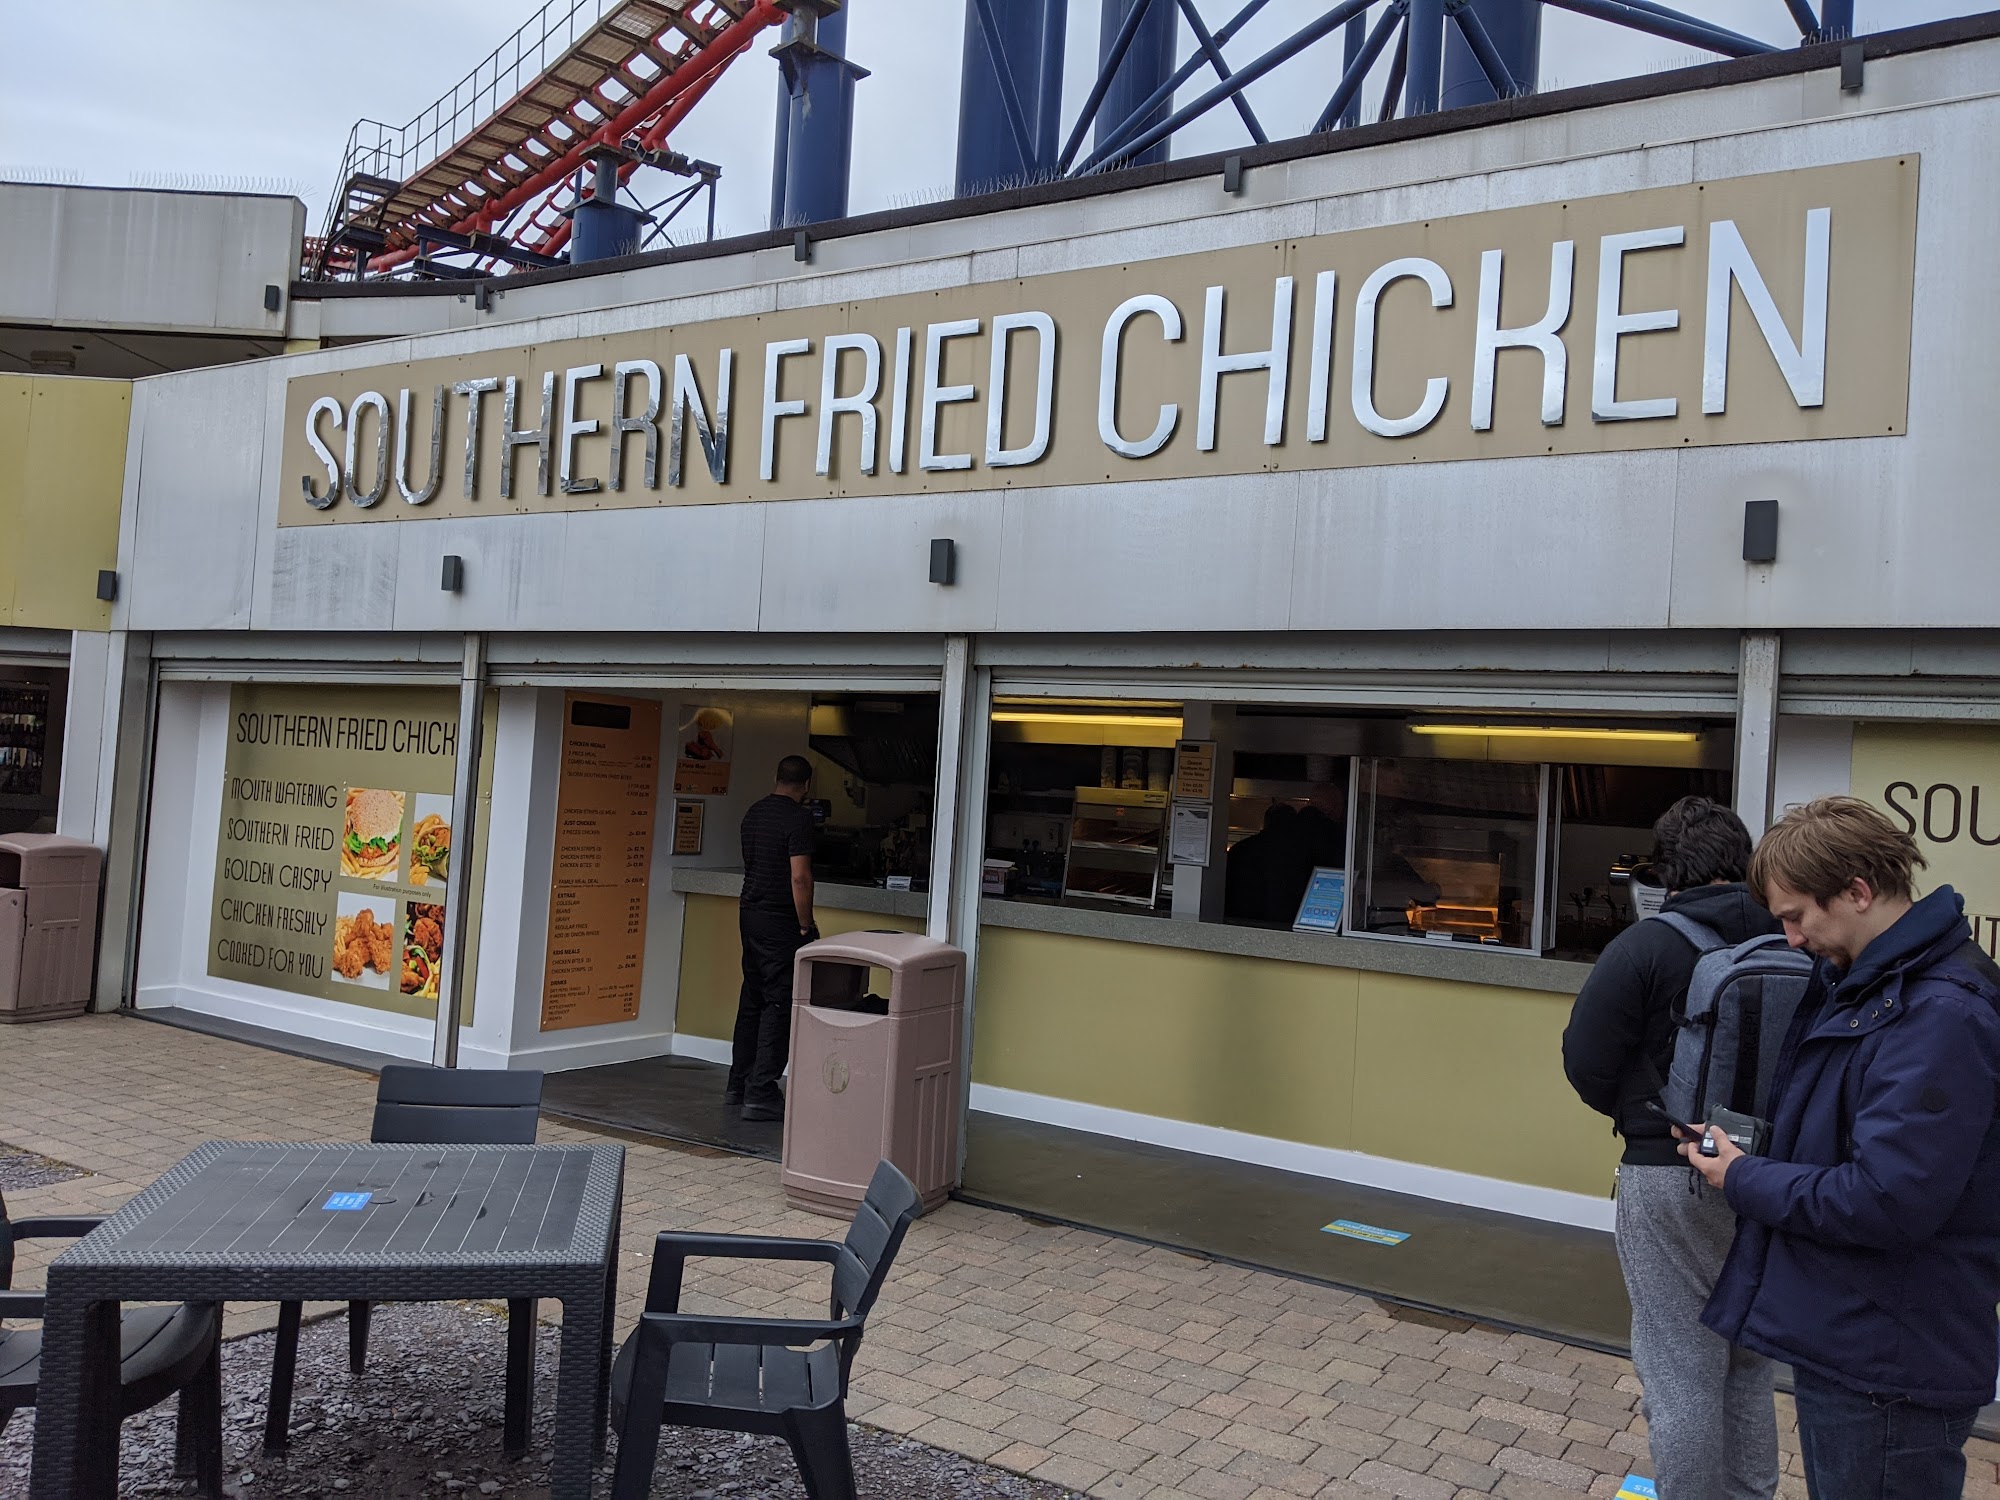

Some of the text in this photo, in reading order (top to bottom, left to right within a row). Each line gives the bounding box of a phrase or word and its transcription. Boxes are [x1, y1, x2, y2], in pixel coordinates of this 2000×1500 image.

[302, 207, 1831, 510] SOUTHERN FRIED CHICKEN
[236, 712, 484, 758] SOUTHERN FRIED CHICK
[231, 777, 338, 809] MOUTH WATERING
[227, 818, 335, 851] SOUTHERN FRIED
[224, 858, 332, 893] GOLDEN CRISPY
[221, 897, 328, 936] CHICKEN FRESHLY
[218, 938, 323, 979] COOKED FOR YOU
[1634, 1485, 1656, 1495] STA
